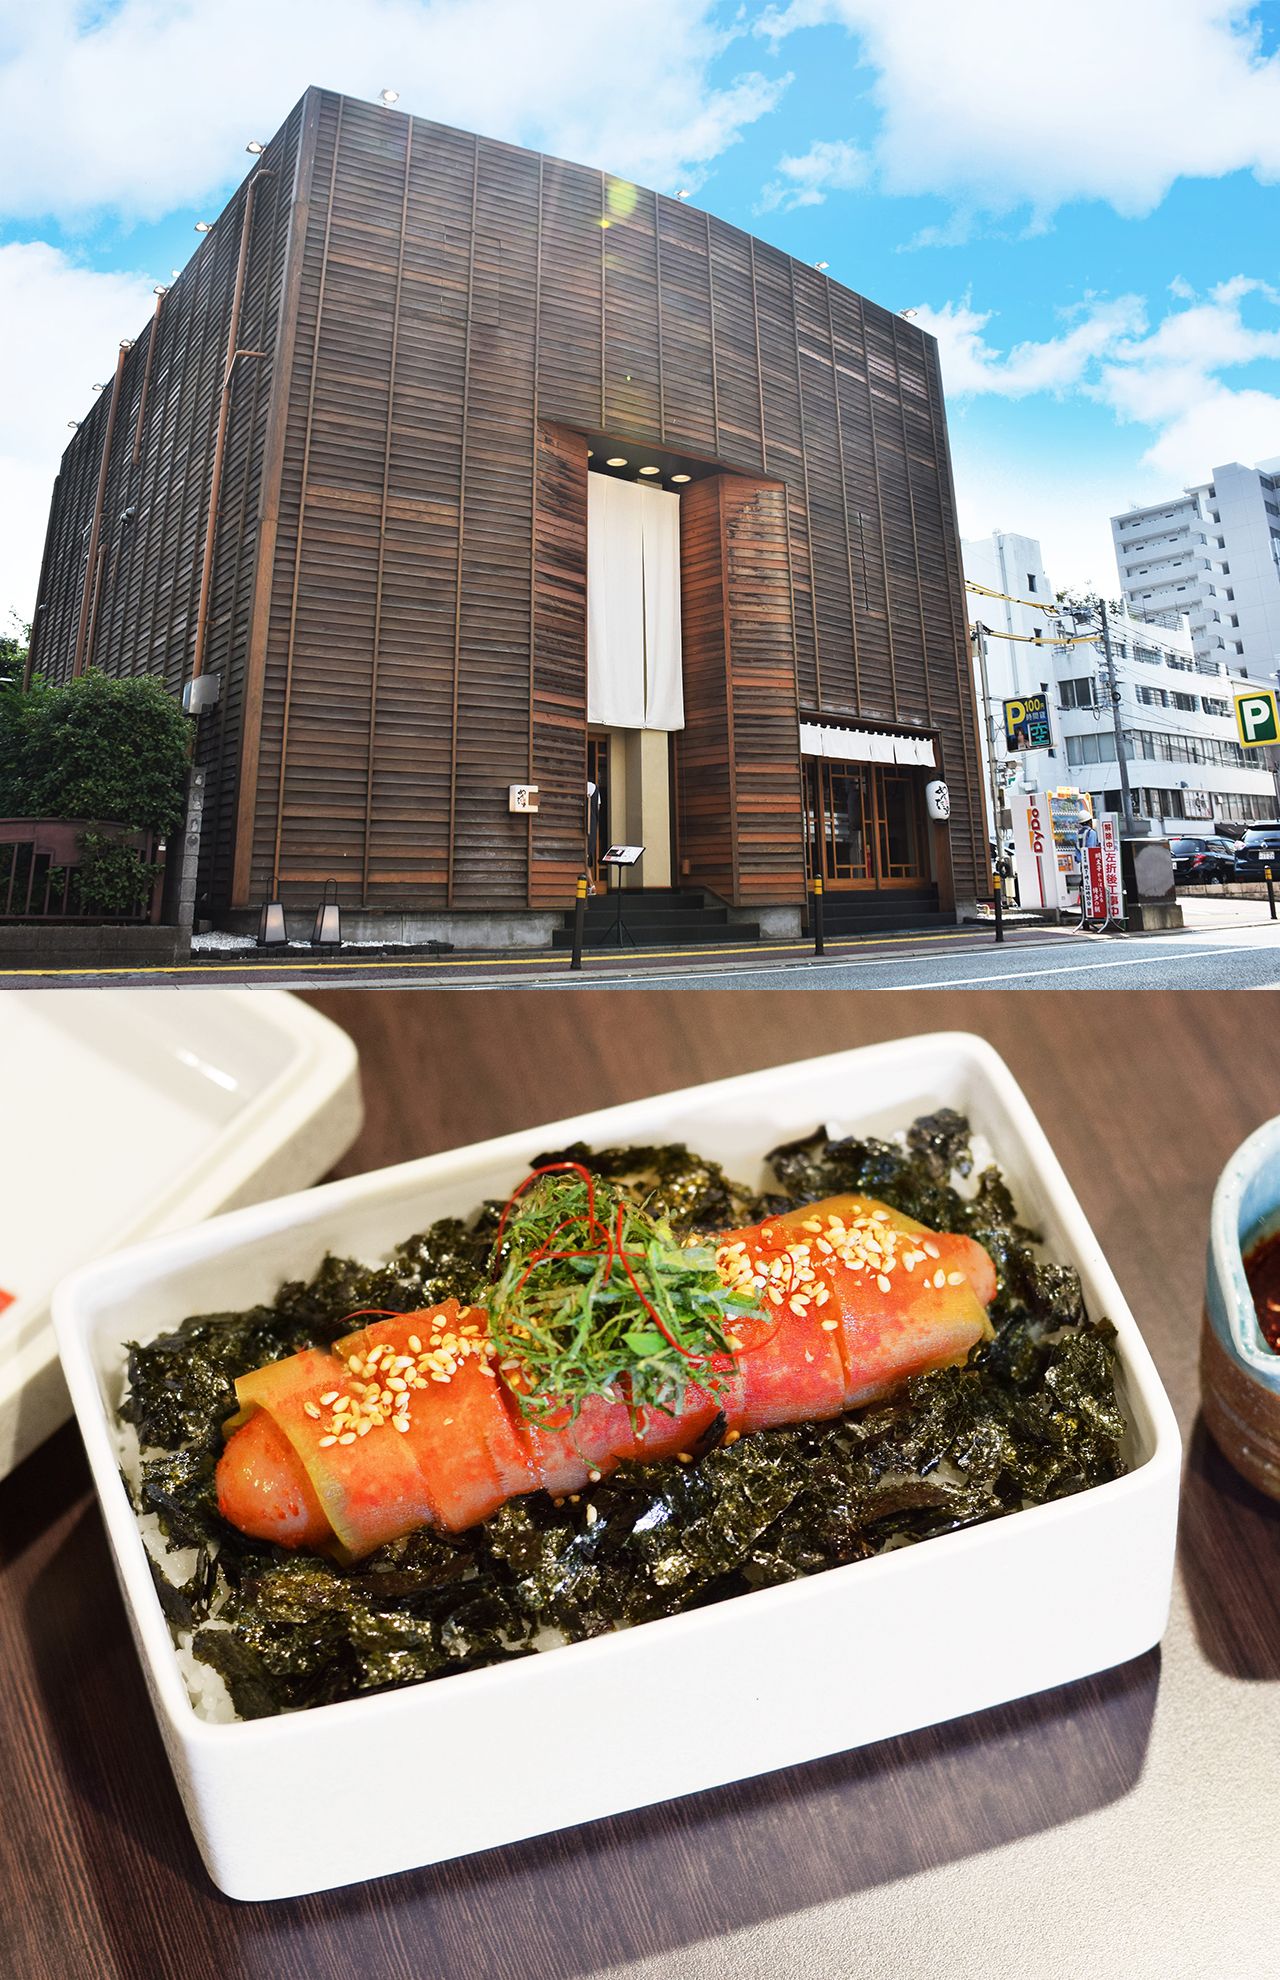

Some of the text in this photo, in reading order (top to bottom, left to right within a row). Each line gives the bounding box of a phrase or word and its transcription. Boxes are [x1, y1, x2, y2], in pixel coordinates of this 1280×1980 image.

[1005, 701, 1026, 735] P
[1030, 722, 1050, 745] 空
[1241, 700, 1270, 740] P
[1031, 808, 1044, 853] DyDo
